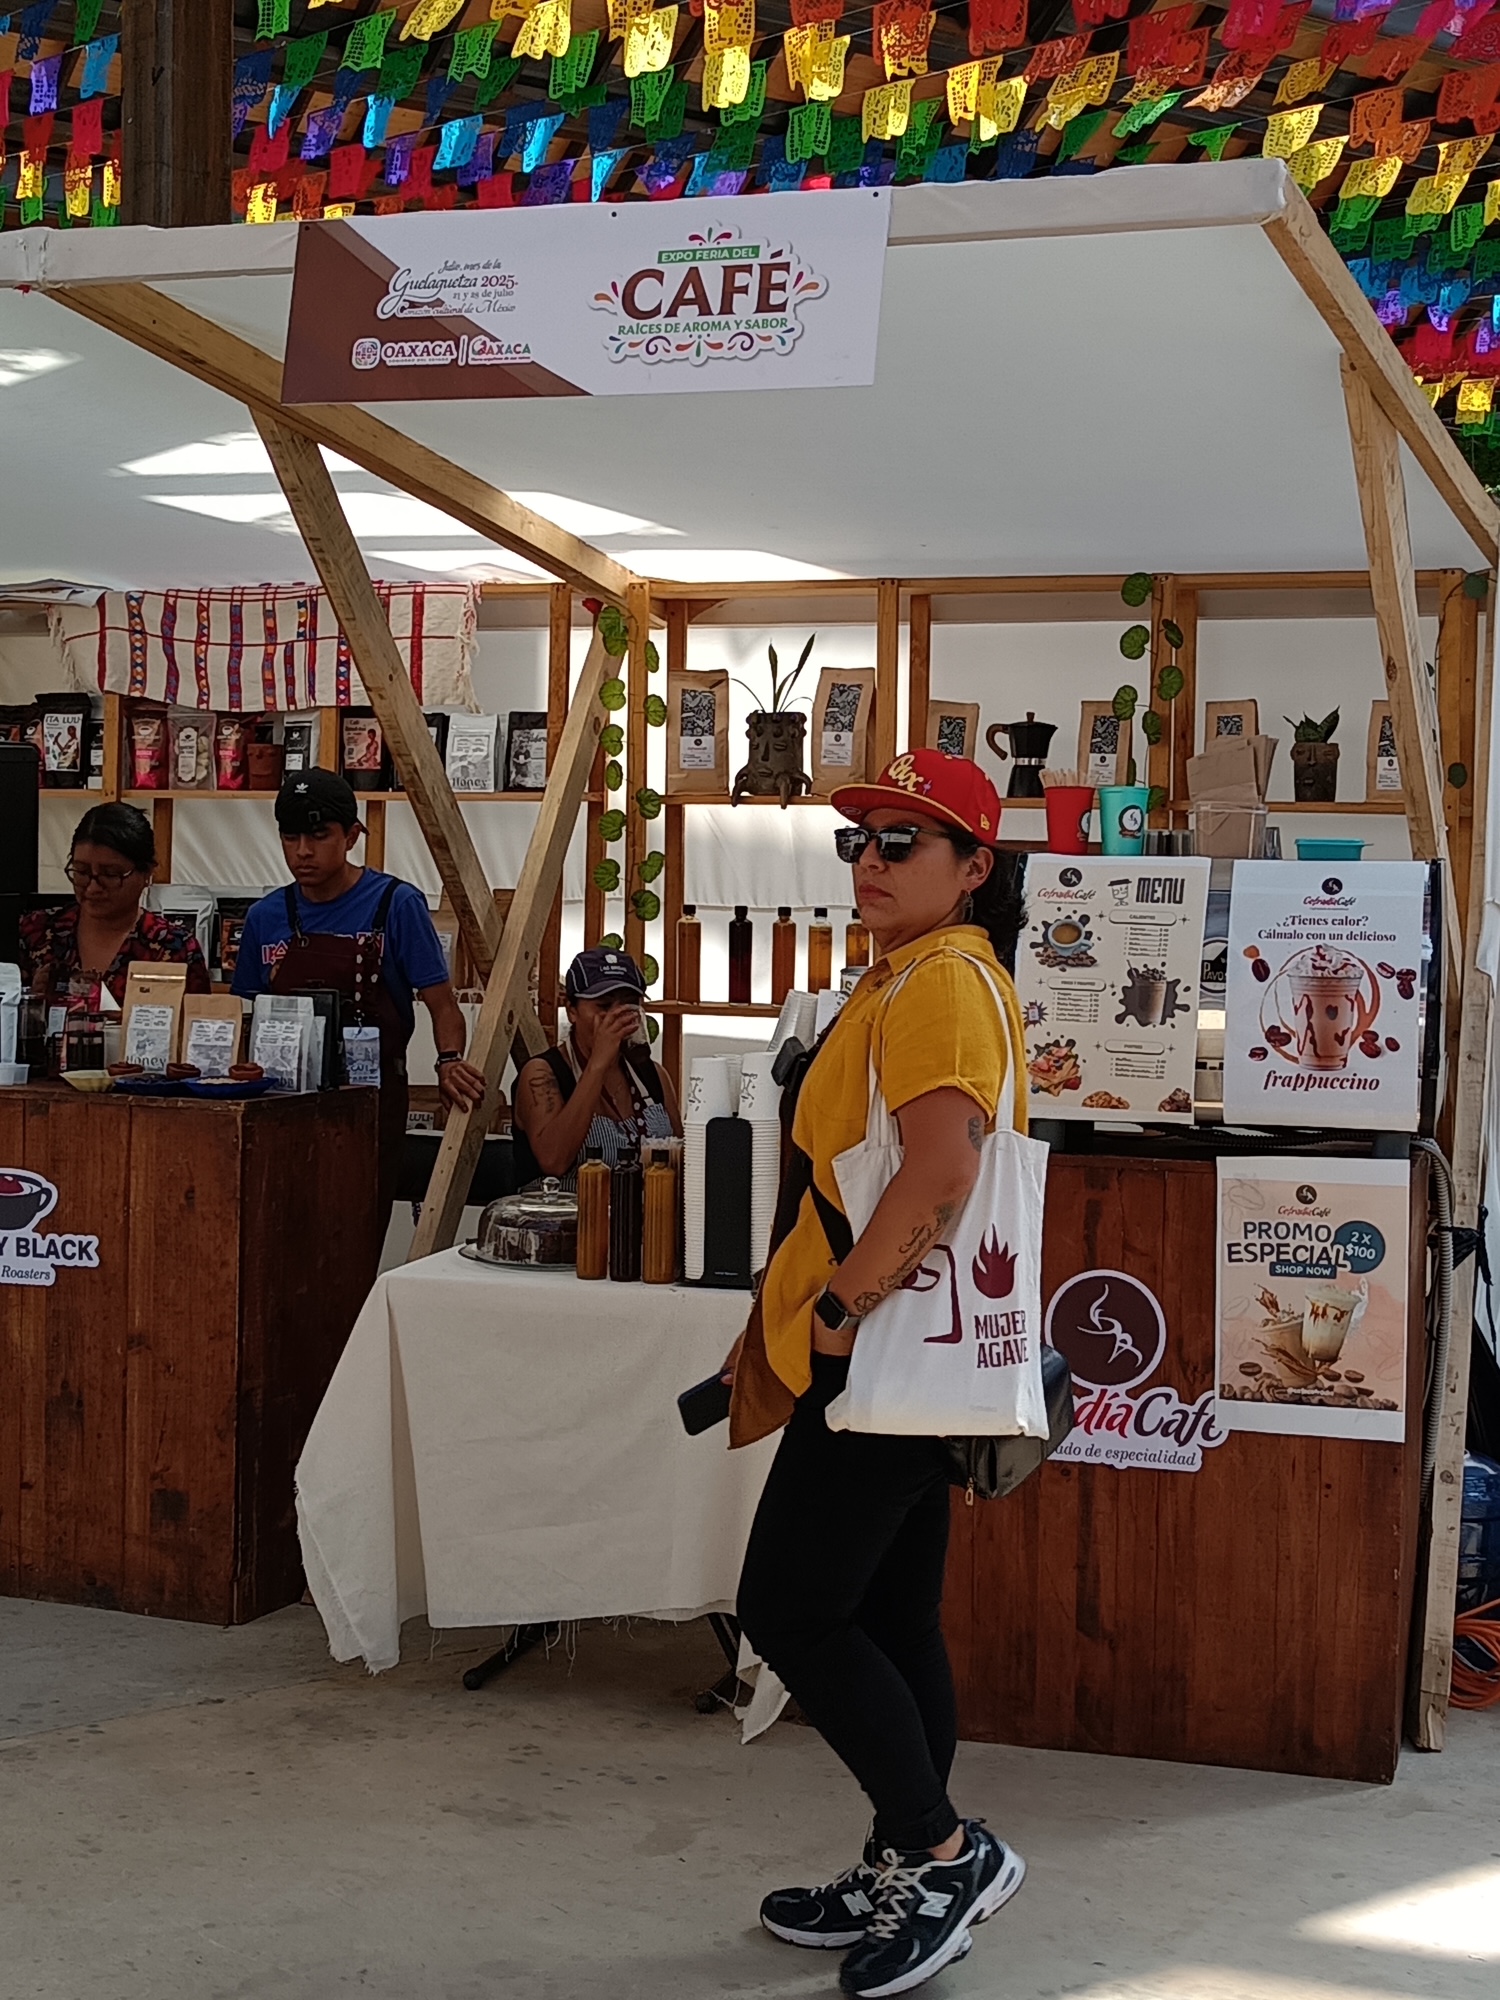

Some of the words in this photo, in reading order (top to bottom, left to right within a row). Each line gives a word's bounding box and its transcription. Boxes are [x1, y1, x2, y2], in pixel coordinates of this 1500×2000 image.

[661, 251, 693, 263] EXPO
[695, 248, 729, 260] FERIA
[732, 246, 756, 259] DEL
[621, 249, 791, 320] CAFÉ
[481, 289, 493, 298] de
[493, 289, 514, 300] julio
[618, 321, 662, 335] RAÍCES
[664, 322, 681, 333] DE
[682, 320, 732, 333] AROMA
[733, 318, 745, 330] Y
[744, 317, 788, 330] SABOR
[383, 344, 454, 359] OAXACA
[1135, 877, 1186, 904] MENU
[1283, 915, 1329, 927] ¿Tienes
[1331, 915, 1369, 926] calor?
[1258, 928, 1304, 940] Cálmalo
[1305, 932, 1326, 940] con
[1329, 932, 1343, 941] un
[1346, 930, 1396, 942] delicioso
[1263, 1070, 1380, 1092] frappuccino
[1243, 1221, 1332, 1243] PROMO
[1351, 1231, 1359, 1243] 2
[16, 1237, 94, 1261] BLACK
[1226, 1242, 1348, 1268] ESPECIAL
[1345, 1243, 1376, 1260] $100
[1, 1265, 51, 1280] Roasters
[1275, 1265, 1304, 1275] SHOP
[1306, 1266, 1332, 1276] NOW
[974, 1310, 1027, 1340] MUJER
[977, 1338, 1029, 1368] AGAVE
[1085, 1443, 1102, 1457] de
[1105, 1448, 1197, 1466] especialidad
